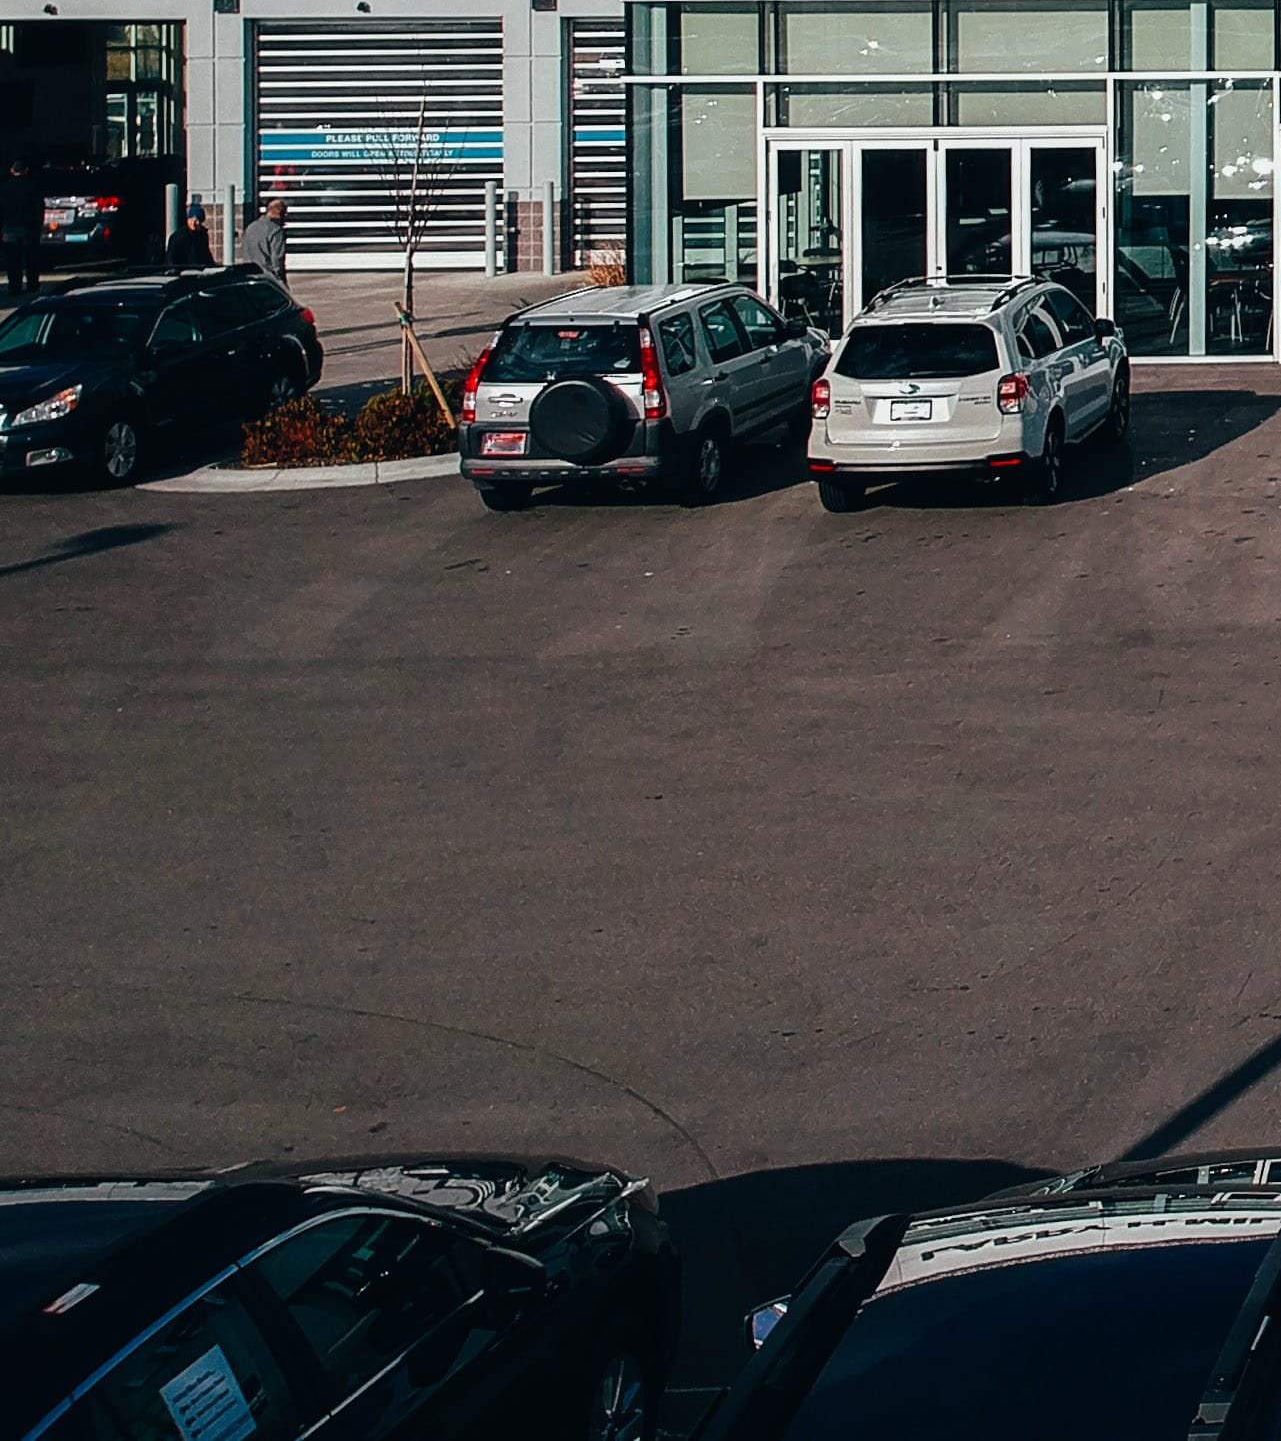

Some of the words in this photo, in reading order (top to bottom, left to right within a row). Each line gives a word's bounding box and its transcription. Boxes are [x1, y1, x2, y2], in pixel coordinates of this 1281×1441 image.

[325, 134, 363, 143] PLEASE
[365, 134, 389, 143] PULL
[311, 150, 340, 158] DOORS
[341, 150, 362, 158] WILL
